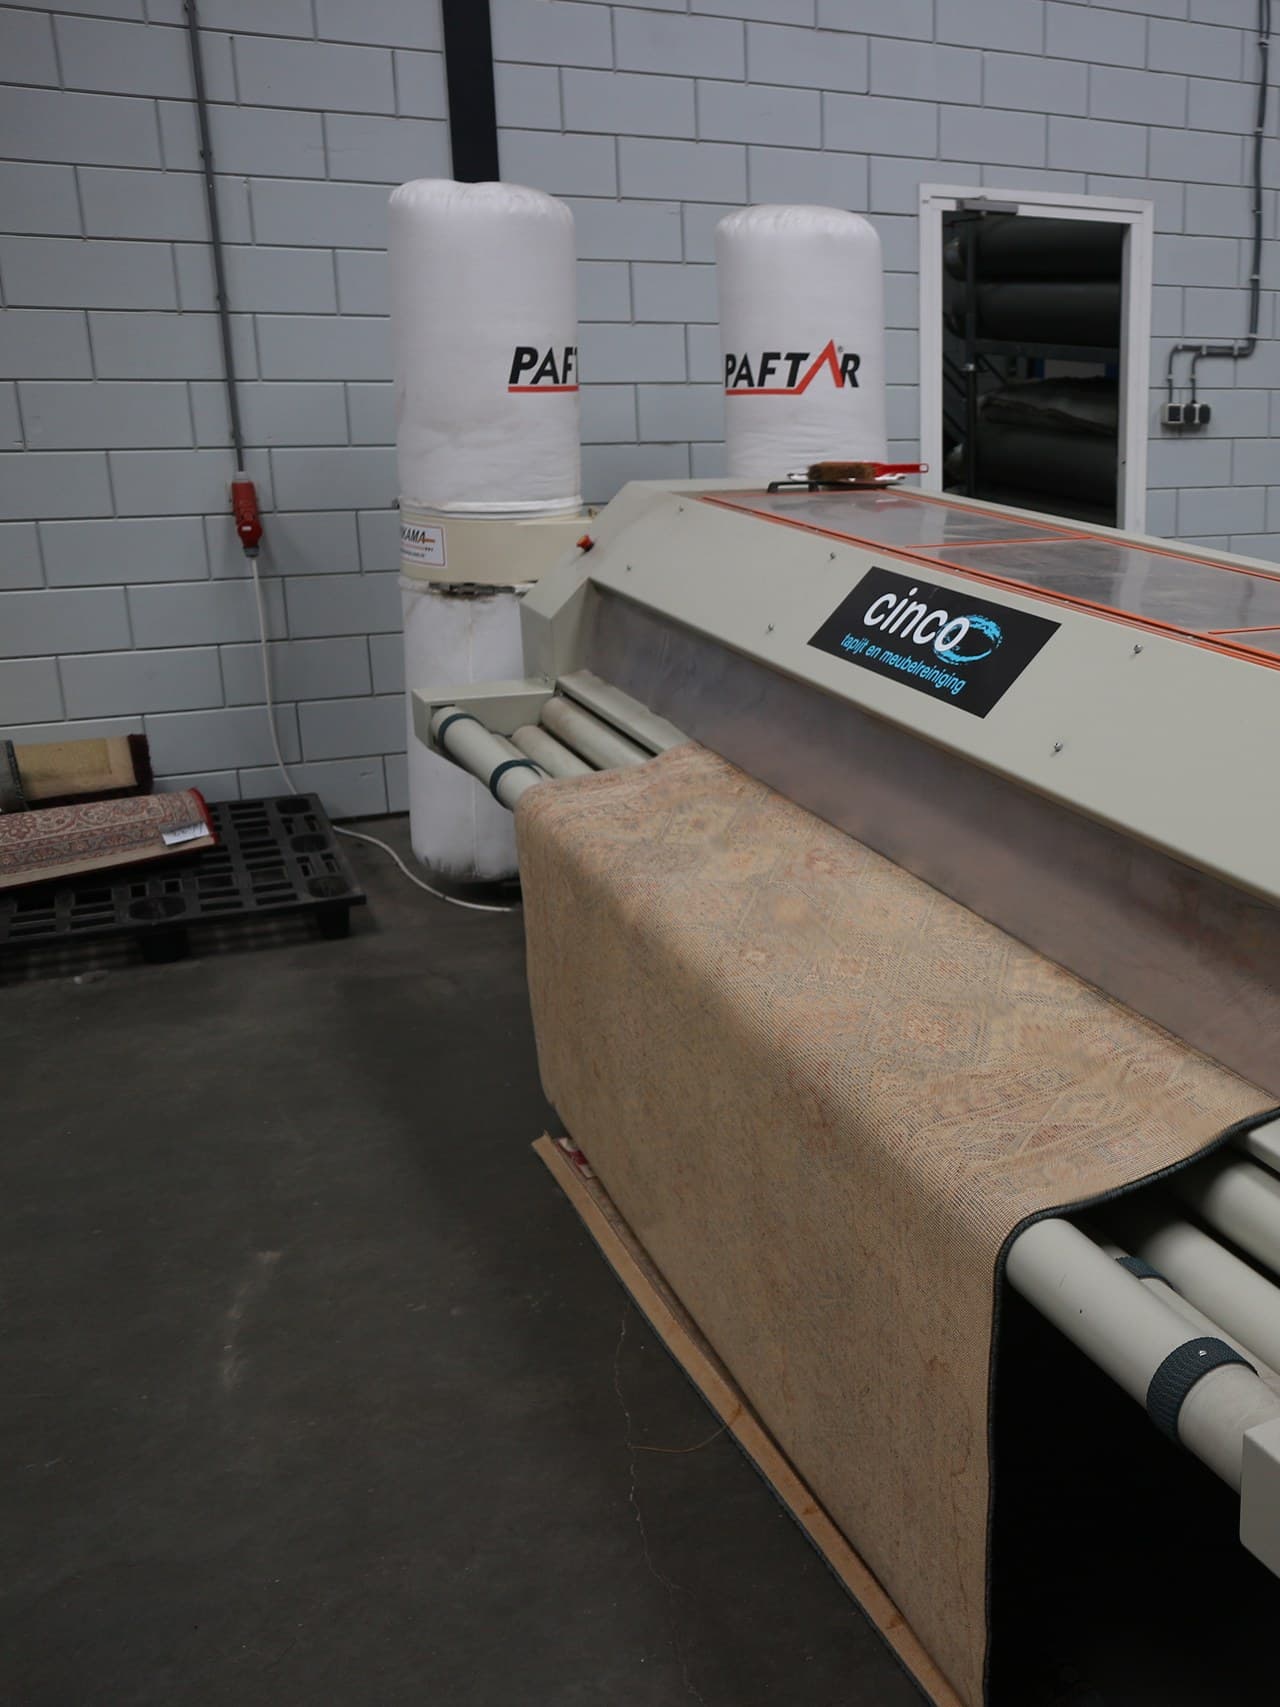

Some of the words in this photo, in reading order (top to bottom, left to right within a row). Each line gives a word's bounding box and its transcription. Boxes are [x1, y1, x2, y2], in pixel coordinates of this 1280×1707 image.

[509, 346, 578, 384] PAF
[864, 587, 970, 651] cinco
[841, 633, 869, 655] tapijt
[866, 645, 881, 659] en
[881, 650, 967, 695] meubelreiniging
